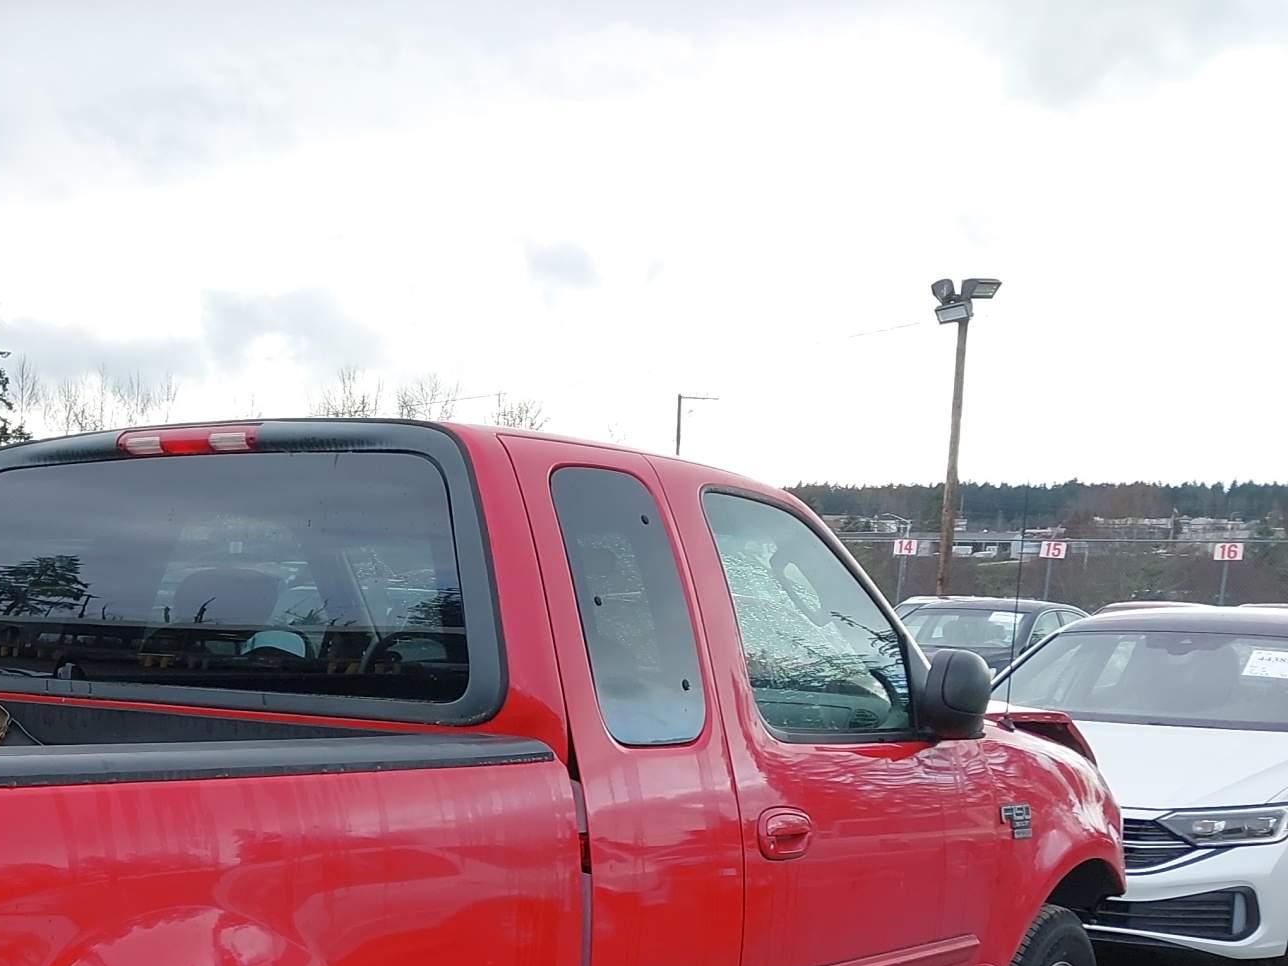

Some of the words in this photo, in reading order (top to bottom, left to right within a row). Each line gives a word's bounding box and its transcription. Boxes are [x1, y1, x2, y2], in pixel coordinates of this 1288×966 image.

[898, 540, 913, 554] 14
[1046, 542, 1062, 557] 15
[1219, 543, 1238, 560] 16
